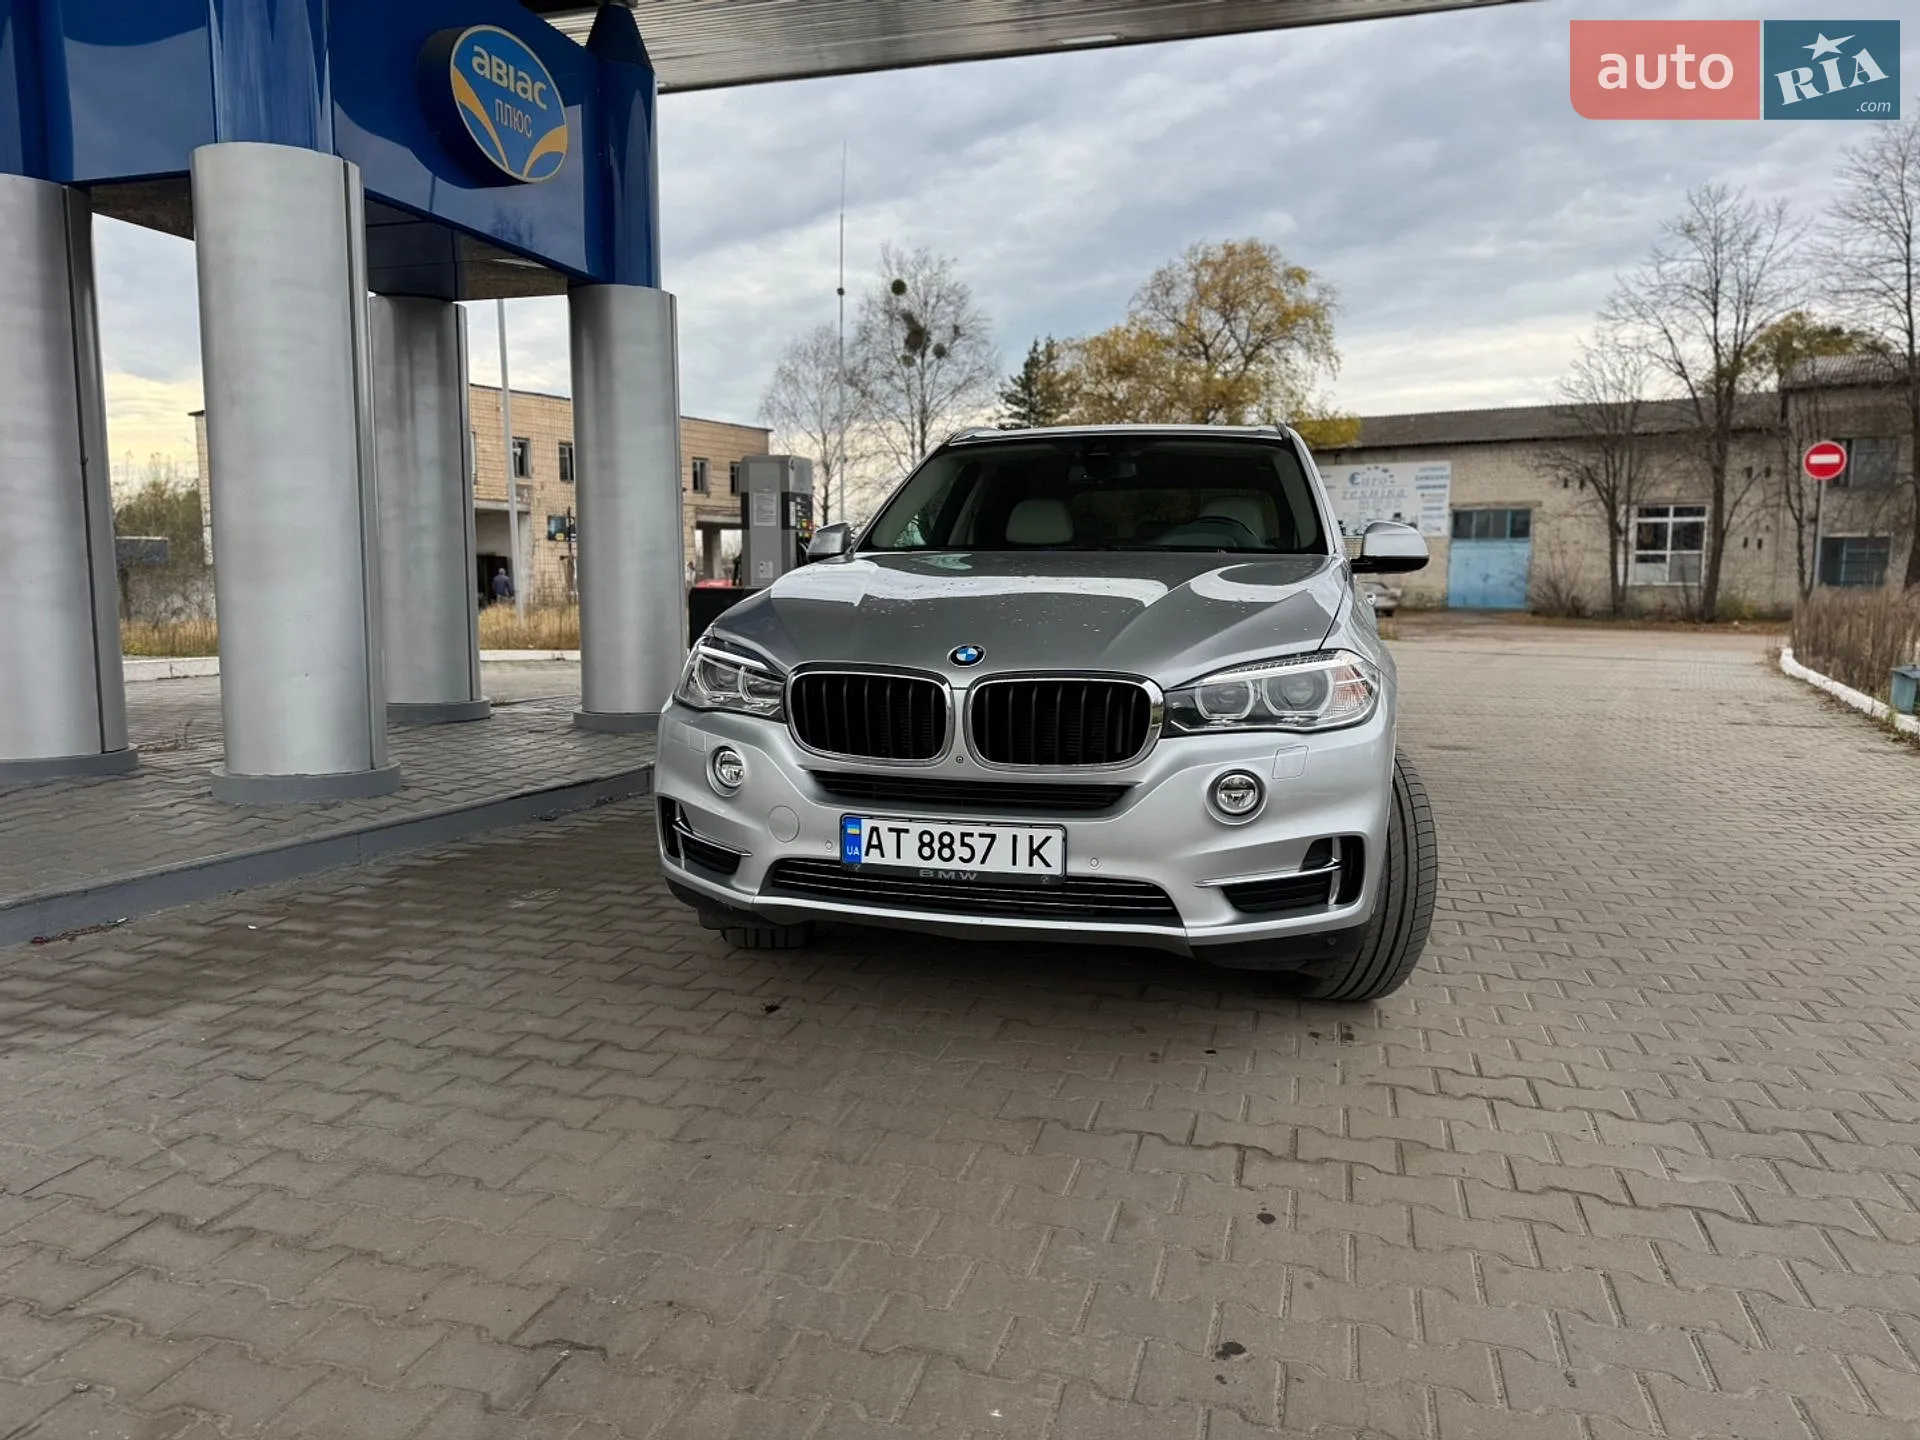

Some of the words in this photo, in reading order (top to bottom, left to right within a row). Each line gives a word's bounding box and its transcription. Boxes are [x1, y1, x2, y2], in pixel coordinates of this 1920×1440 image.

[846, 845, 861, 856] UA
[864, 826, 910, 860] AT
[917, 829, 997, 865] 8857
[1011, 834, 1053, 868] IK
[918, 868, 979, 881] BMW
